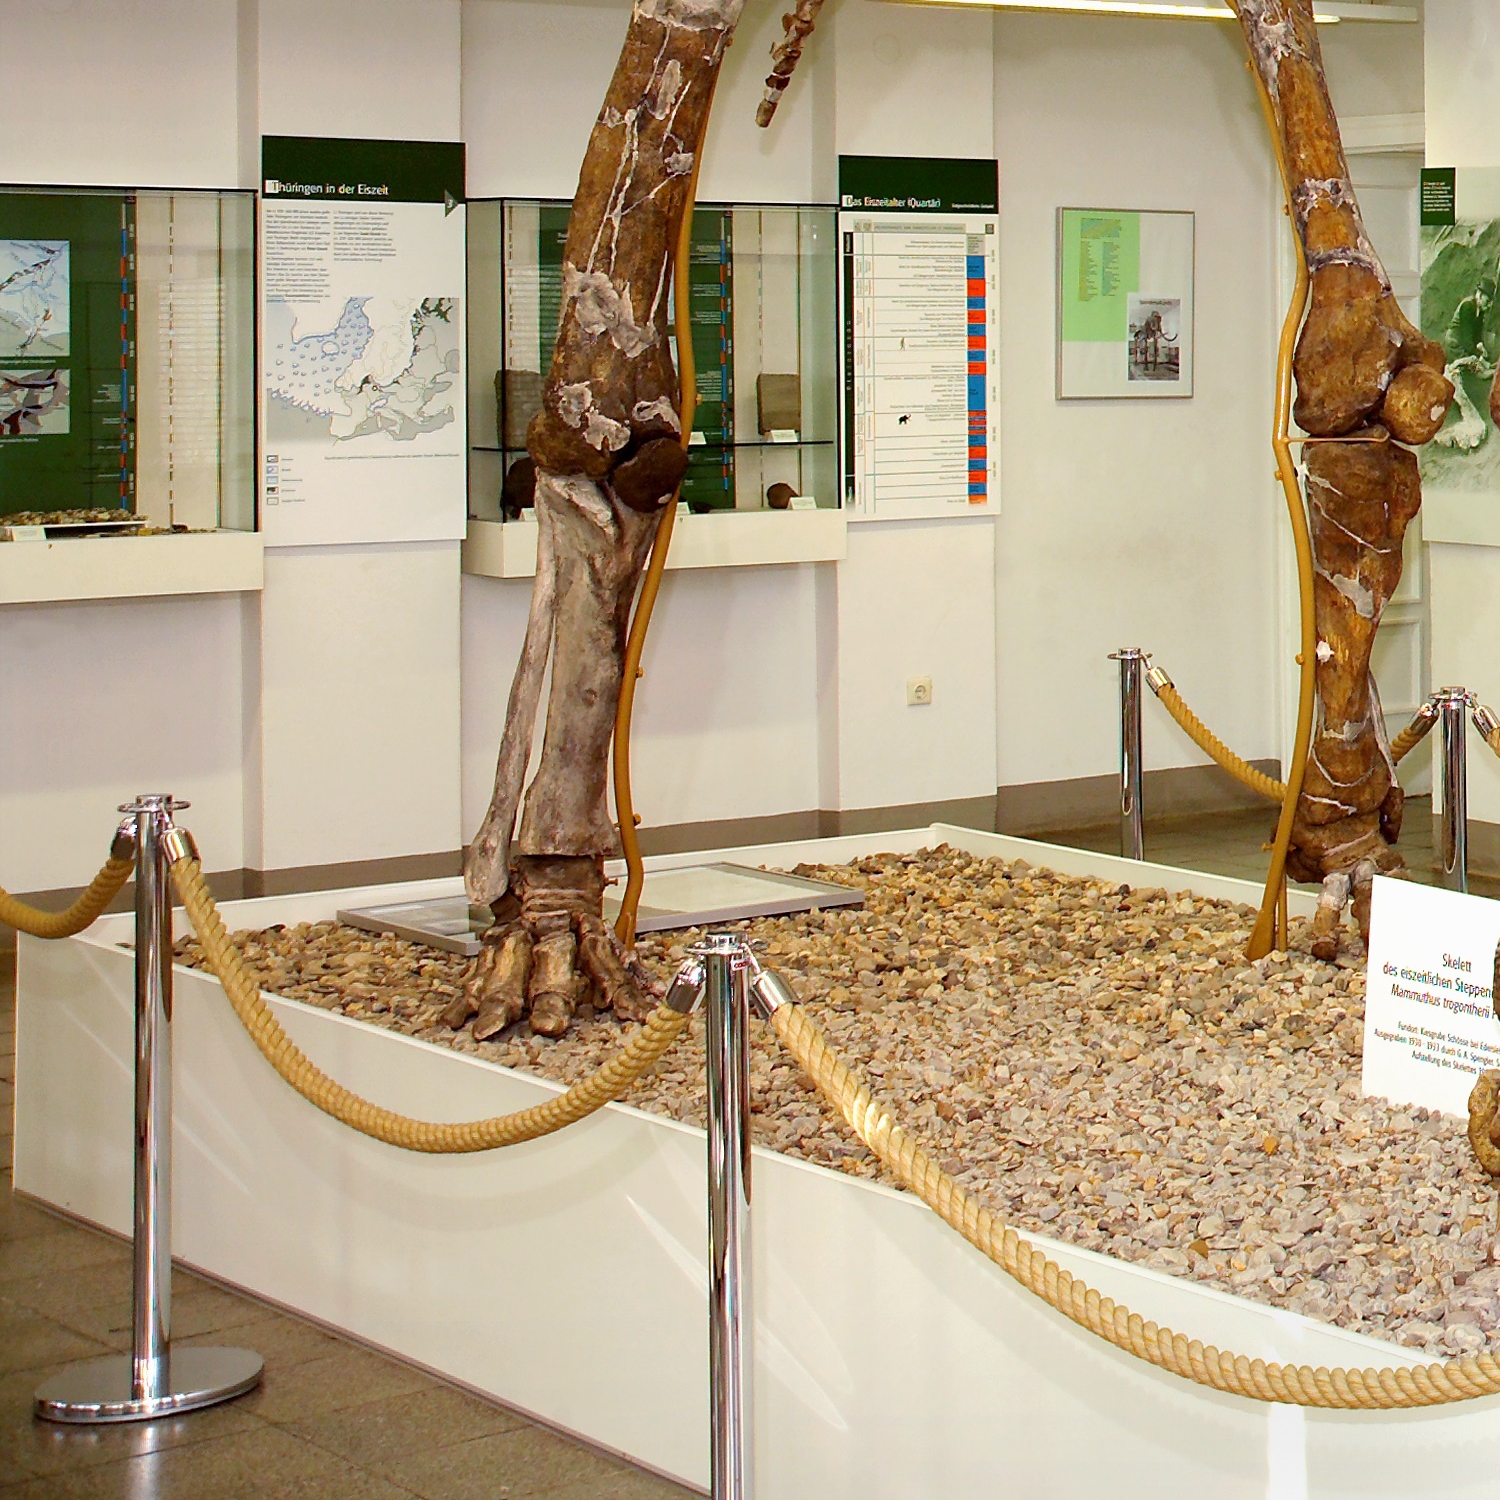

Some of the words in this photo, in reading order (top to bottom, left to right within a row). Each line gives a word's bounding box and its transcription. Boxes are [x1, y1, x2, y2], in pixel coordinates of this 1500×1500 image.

[273, 182, 323, 196] Thüringen
[326, 183, 335, 194] in
[338, 183, 355, 194] der
[358, 183, 389, 195] Eiszeit
[846, 196, 862, 207] Das
[864, 196, 905, 207] Eiszeitalter
[907, 197, 941, 208] (Quartär)
[1442, 953, 1472, 973] Skelett
[1383, 961, 1398, 976] des
[1400, 966, 1452, 990] eiszeitlichen
[1391, 983, 1441, 1008] Mammuthus
[1470, 1038, 1479, 1049] bei
[1441, 1045, 1456, 1057] durch
[1442, 1058, 1452, 1068] des
